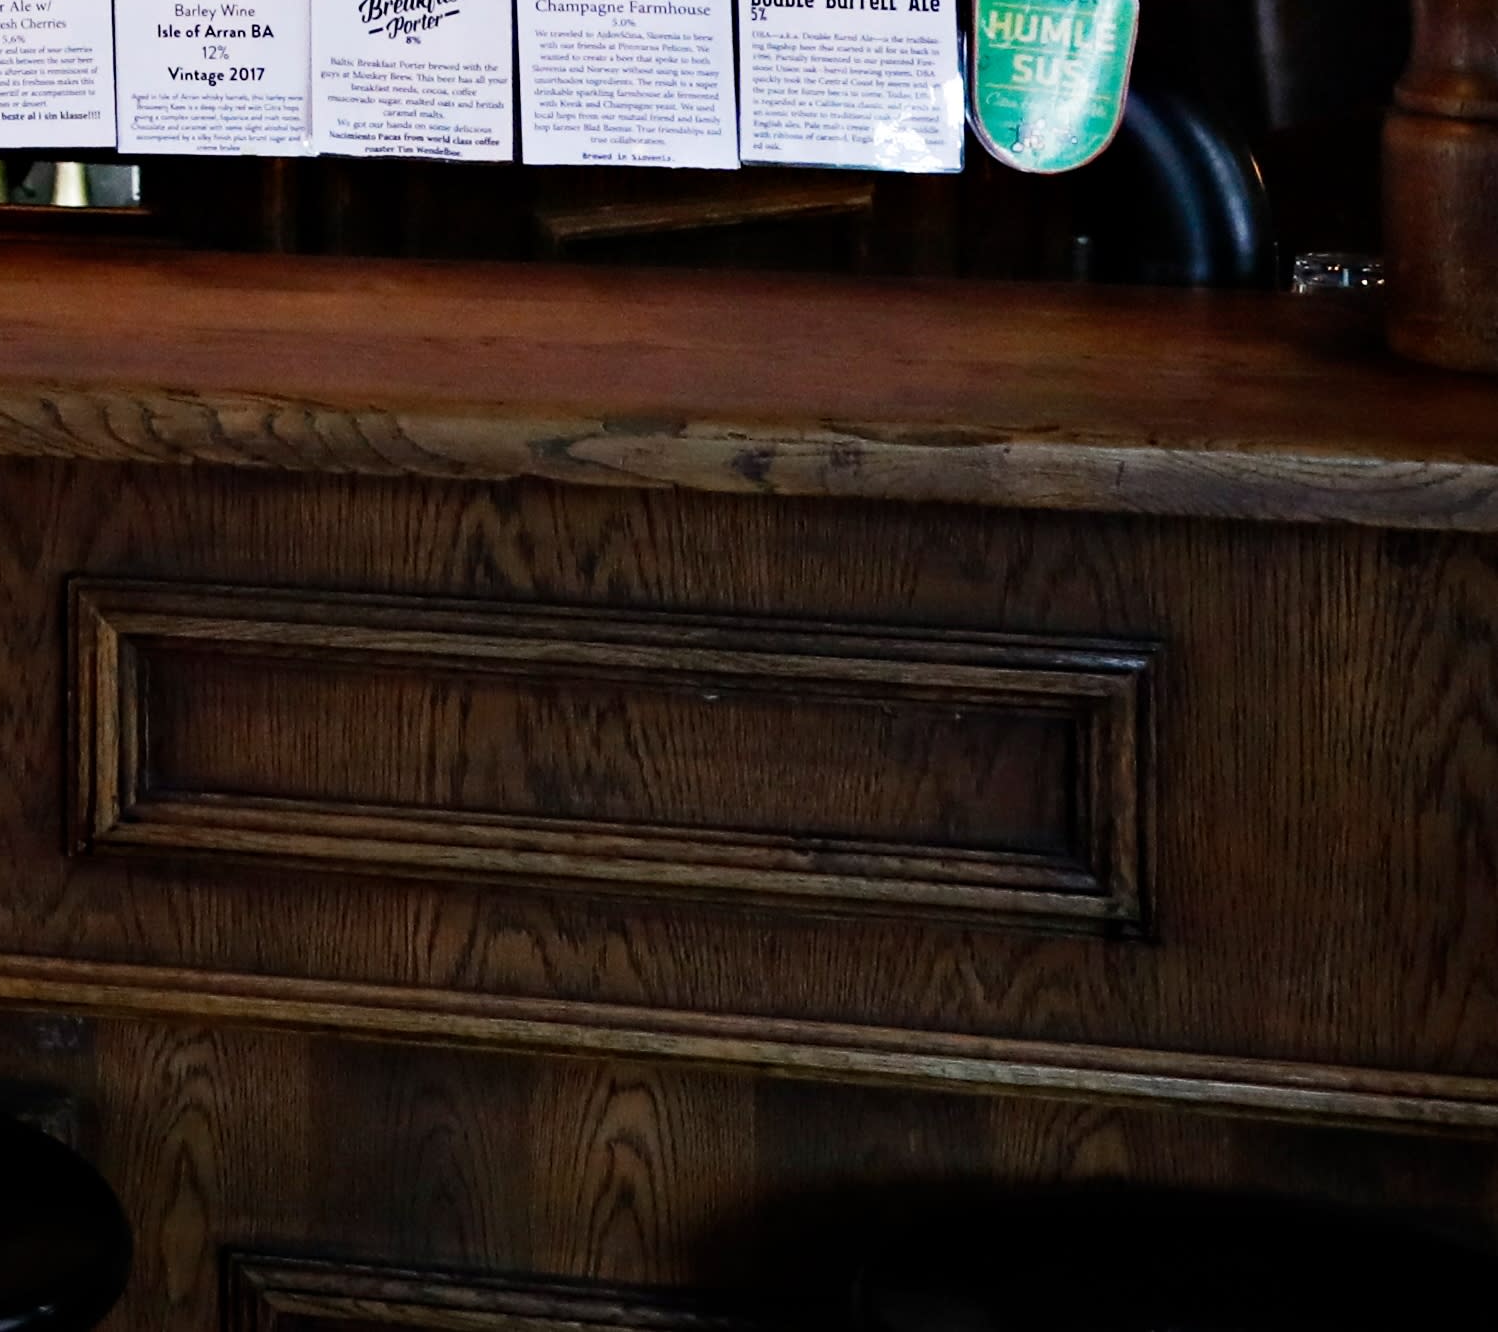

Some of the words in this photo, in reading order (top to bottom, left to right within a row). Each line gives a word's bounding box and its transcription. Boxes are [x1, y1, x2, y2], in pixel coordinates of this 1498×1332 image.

[10, 1, 31, 12] Ale
[175, 5, 216, 19] Barley
[220, 5, 255, 16] Wine
[535, 0, 625, 17] Champagne
[629, 0, 711, 16] Farmhouse
[21, 19, 66, 30] Cherries
[157, 25, 180, 37] Isle
[186, 24, 201, 37] of
[205, 25, 247, 37] Arran
[252, 25, 274, 37] BA
[385, 14, 443, 39] Porter
[988, 12, 1115, 52] HUMLE
[202, 46, 229, 59] 12%
[168, 68, 225, 85] Vintage
[229, 68, 265, 82] 2017
